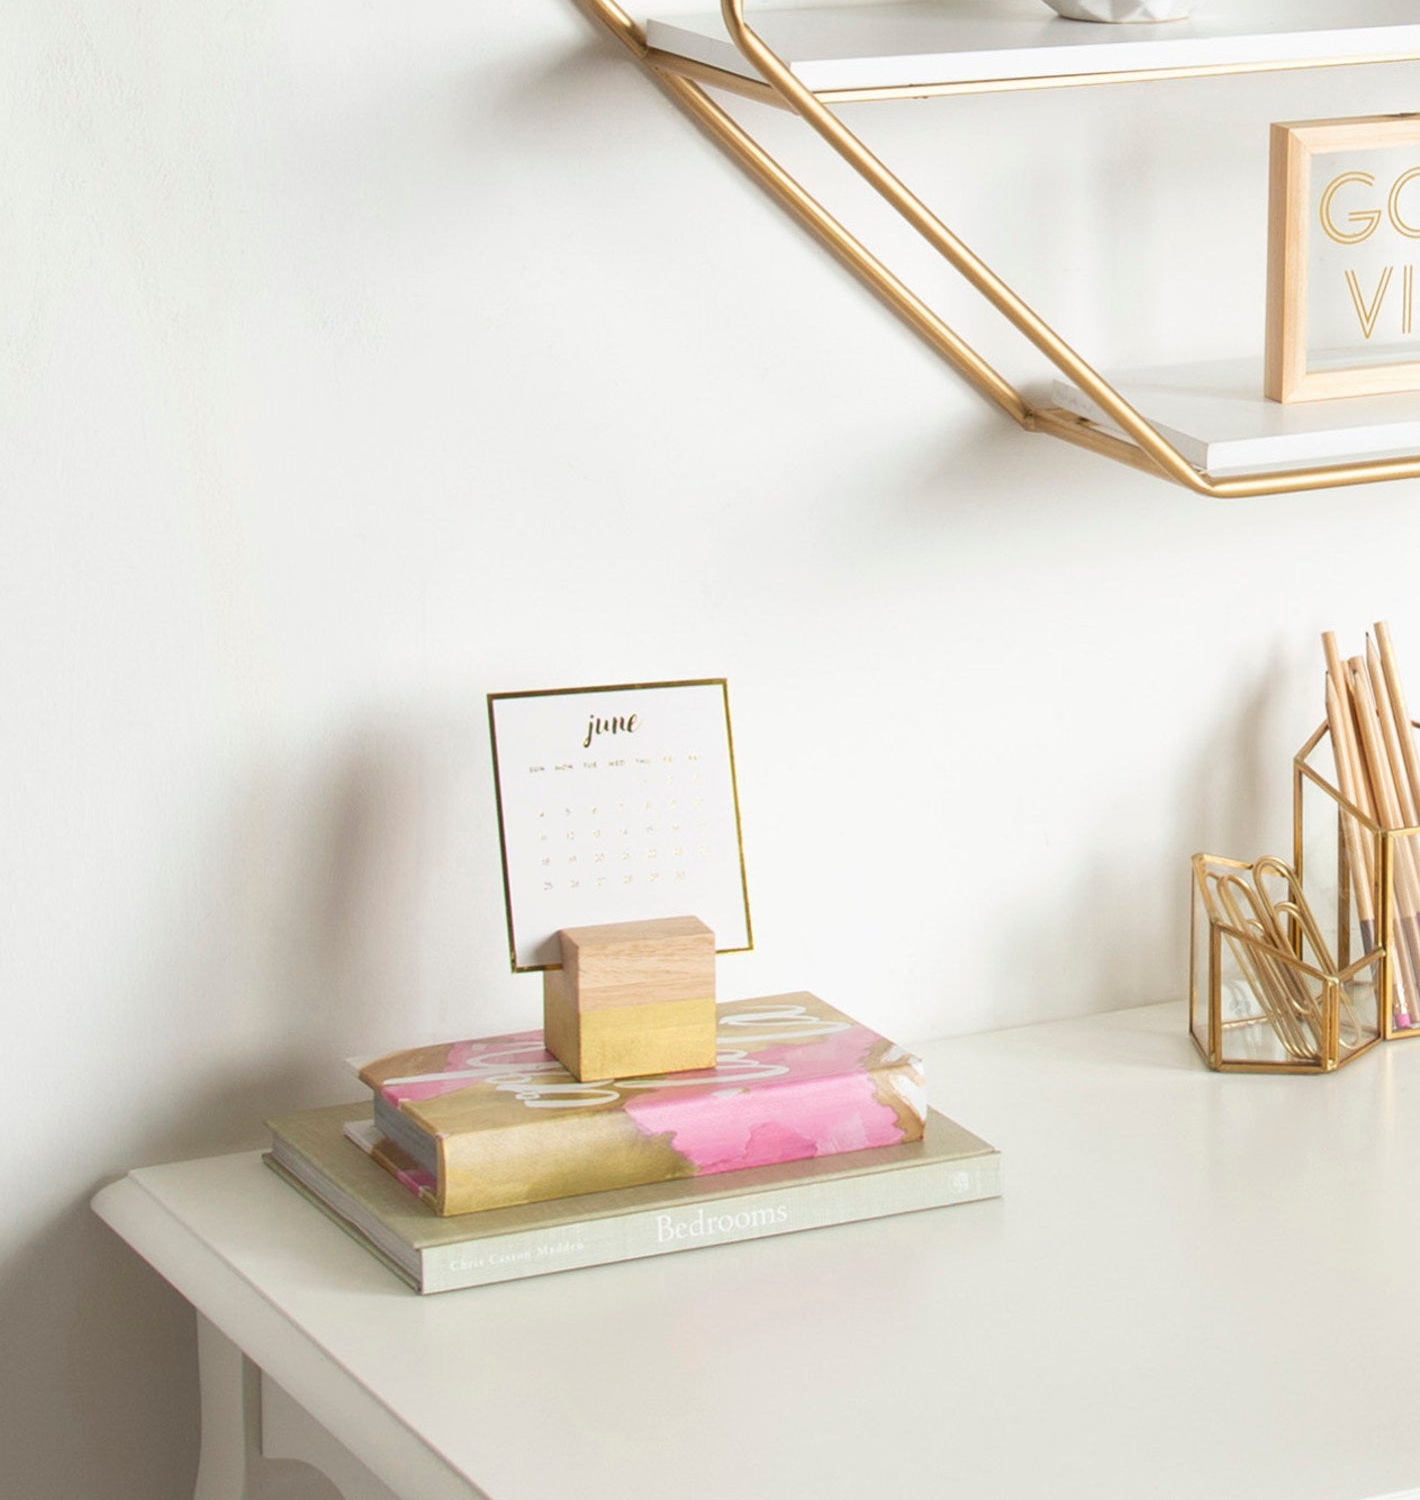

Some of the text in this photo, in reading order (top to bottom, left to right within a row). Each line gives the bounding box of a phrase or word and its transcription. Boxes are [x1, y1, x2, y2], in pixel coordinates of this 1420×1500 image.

[582, 713, 641, 749] june
[655, 1203, 789, 1243] Bedrooms
[450, 1256, 485, 1272] Chris
[537, 1241, 585, 1257] Madden
